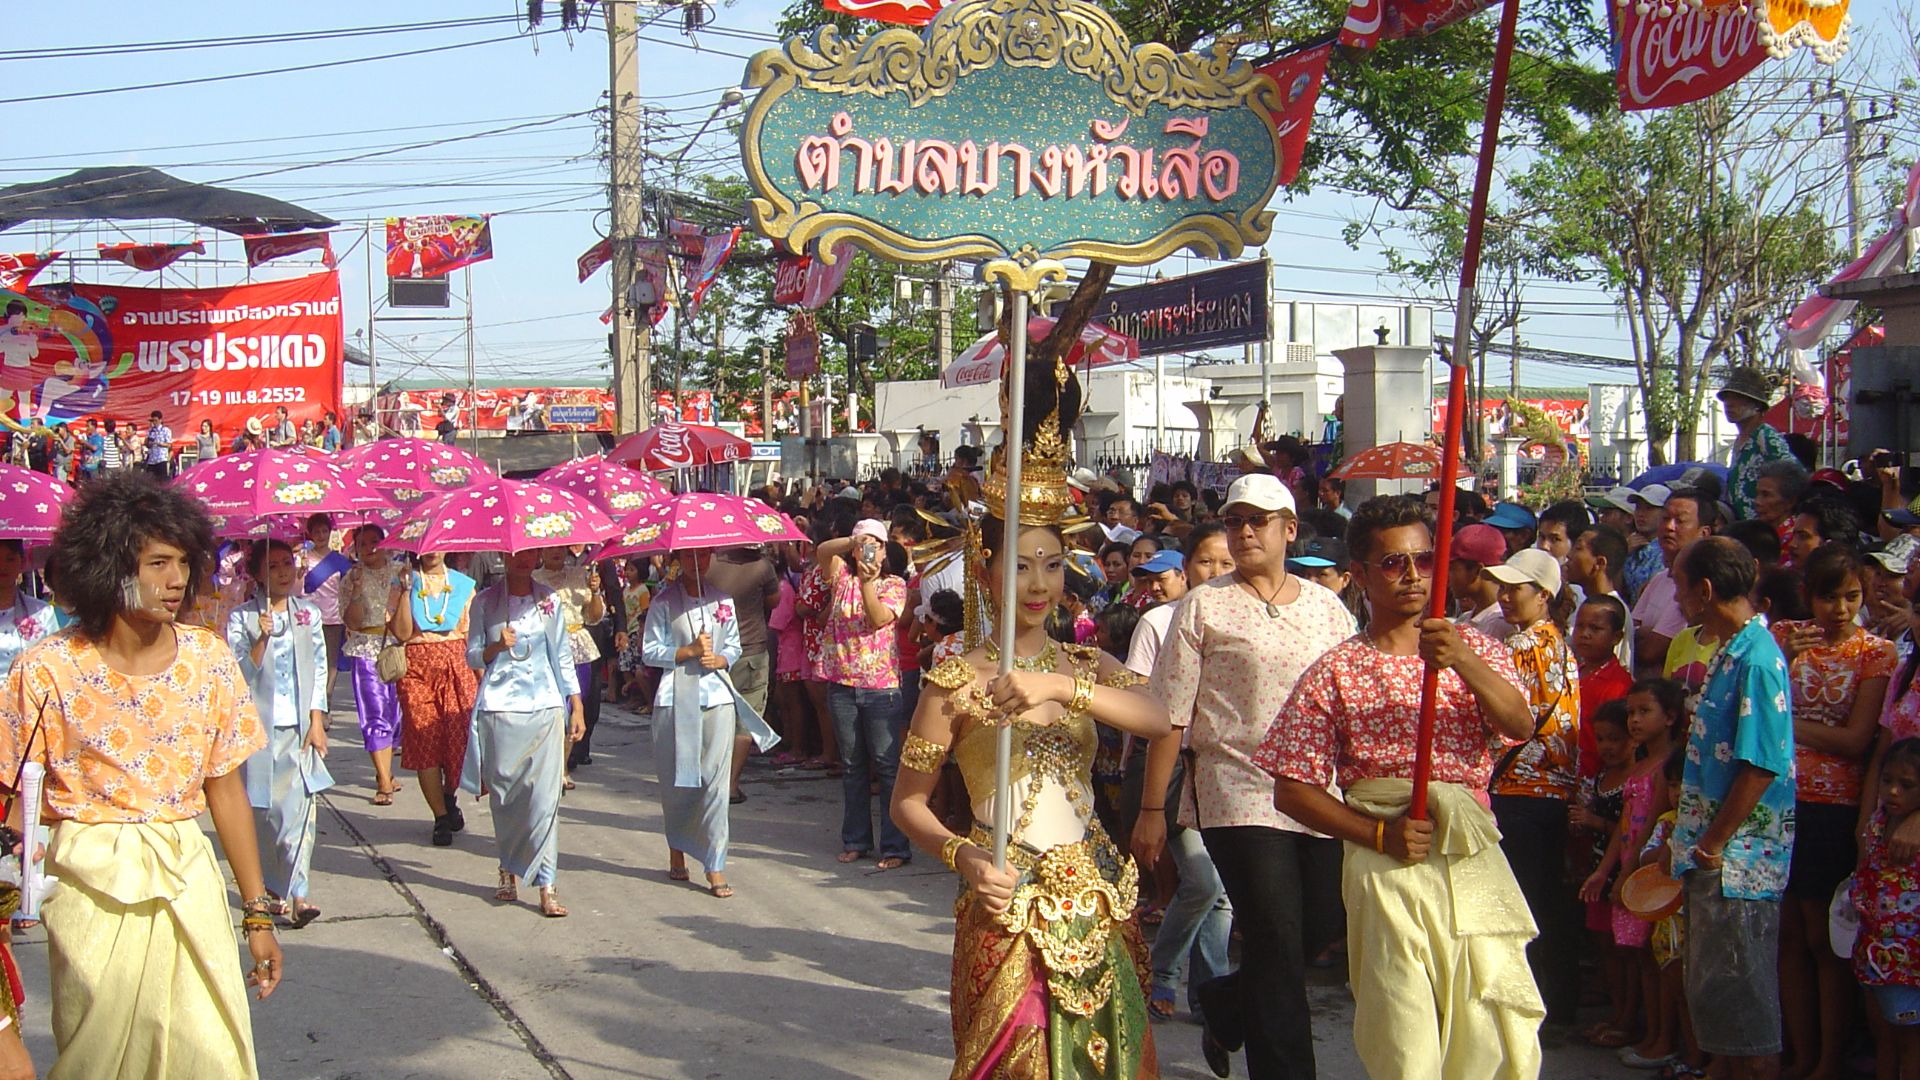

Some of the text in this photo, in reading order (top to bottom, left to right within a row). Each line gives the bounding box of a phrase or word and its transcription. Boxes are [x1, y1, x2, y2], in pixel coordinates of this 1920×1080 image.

[797, 111, 1241, 200] ตำบลบางหัวเสือ
[123, 297, 338, 325] งานประเพณีสงกรานต์
[138, 332, 326, 373] พระประแดง
[170, 390, 222, 406] 17-19
